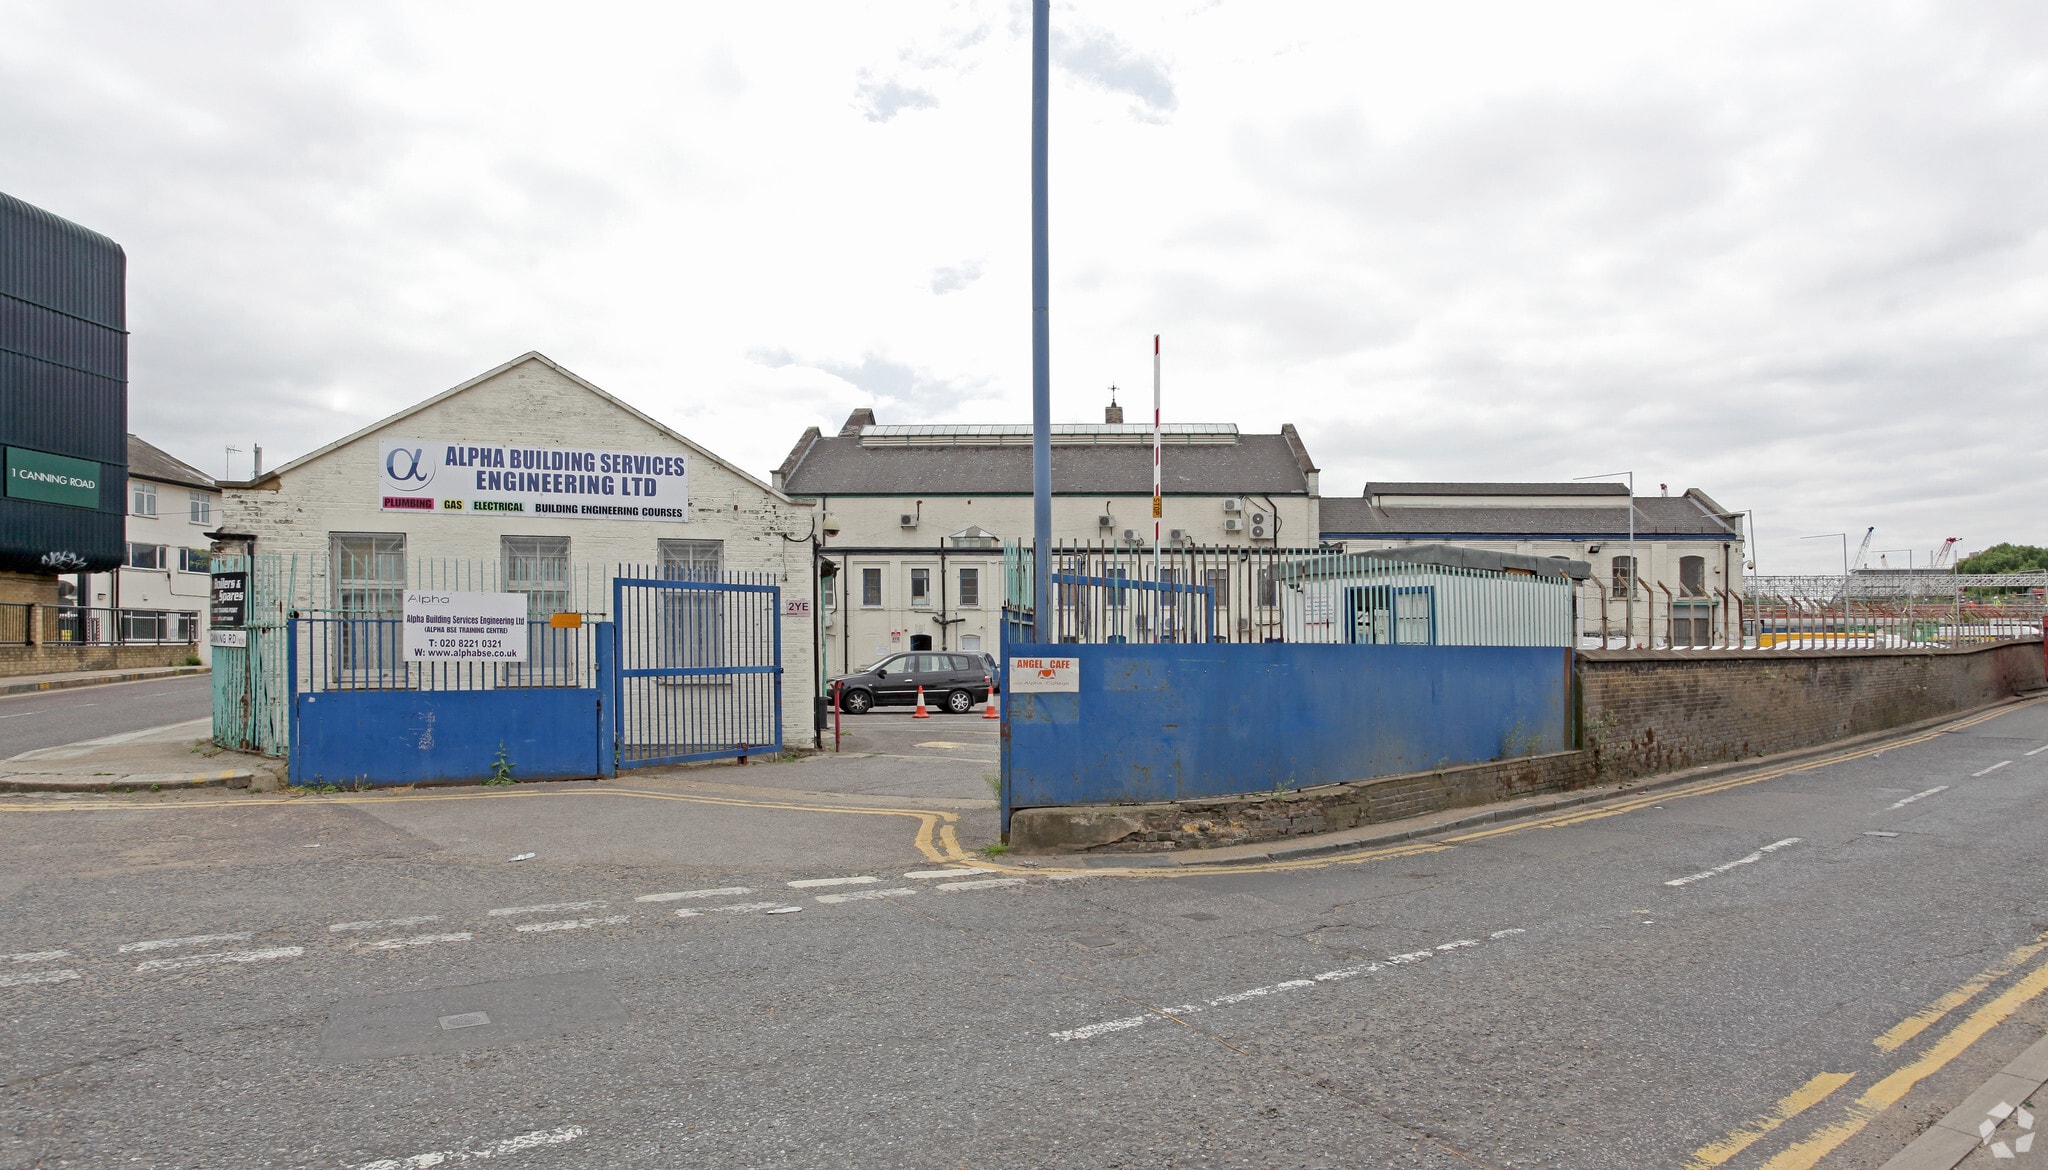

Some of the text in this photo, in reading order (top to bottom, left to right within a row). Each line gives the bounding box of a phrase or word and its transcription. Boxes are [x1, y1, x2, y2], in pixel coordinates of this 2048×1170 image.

[445, 446, 685, 476] ALPHA BUILDING SERVICES
[12, 468, 96, 489] 1 CANNING ROAD
[476, 470, 657, 496] ENGINEERING LTD
[384, 498, 683, 517] PLUMBING GAS ELECTRICAL BUILDING ENGINEERING COURSES
[219, 590, 244, 604] Spares
[408, 594, 450, 604] Alpha
[788, 602, 809, 611] 2YE
[406, 614, 525, 626] Alpha Building Services Engineering Ltd
[428, 639, 502, 648] T: 020 8221 0321
[414, 648, 517, 659] W: www.alphabse.co.uk
[1017, 659, 1070, 669] ANGEL CAFE
